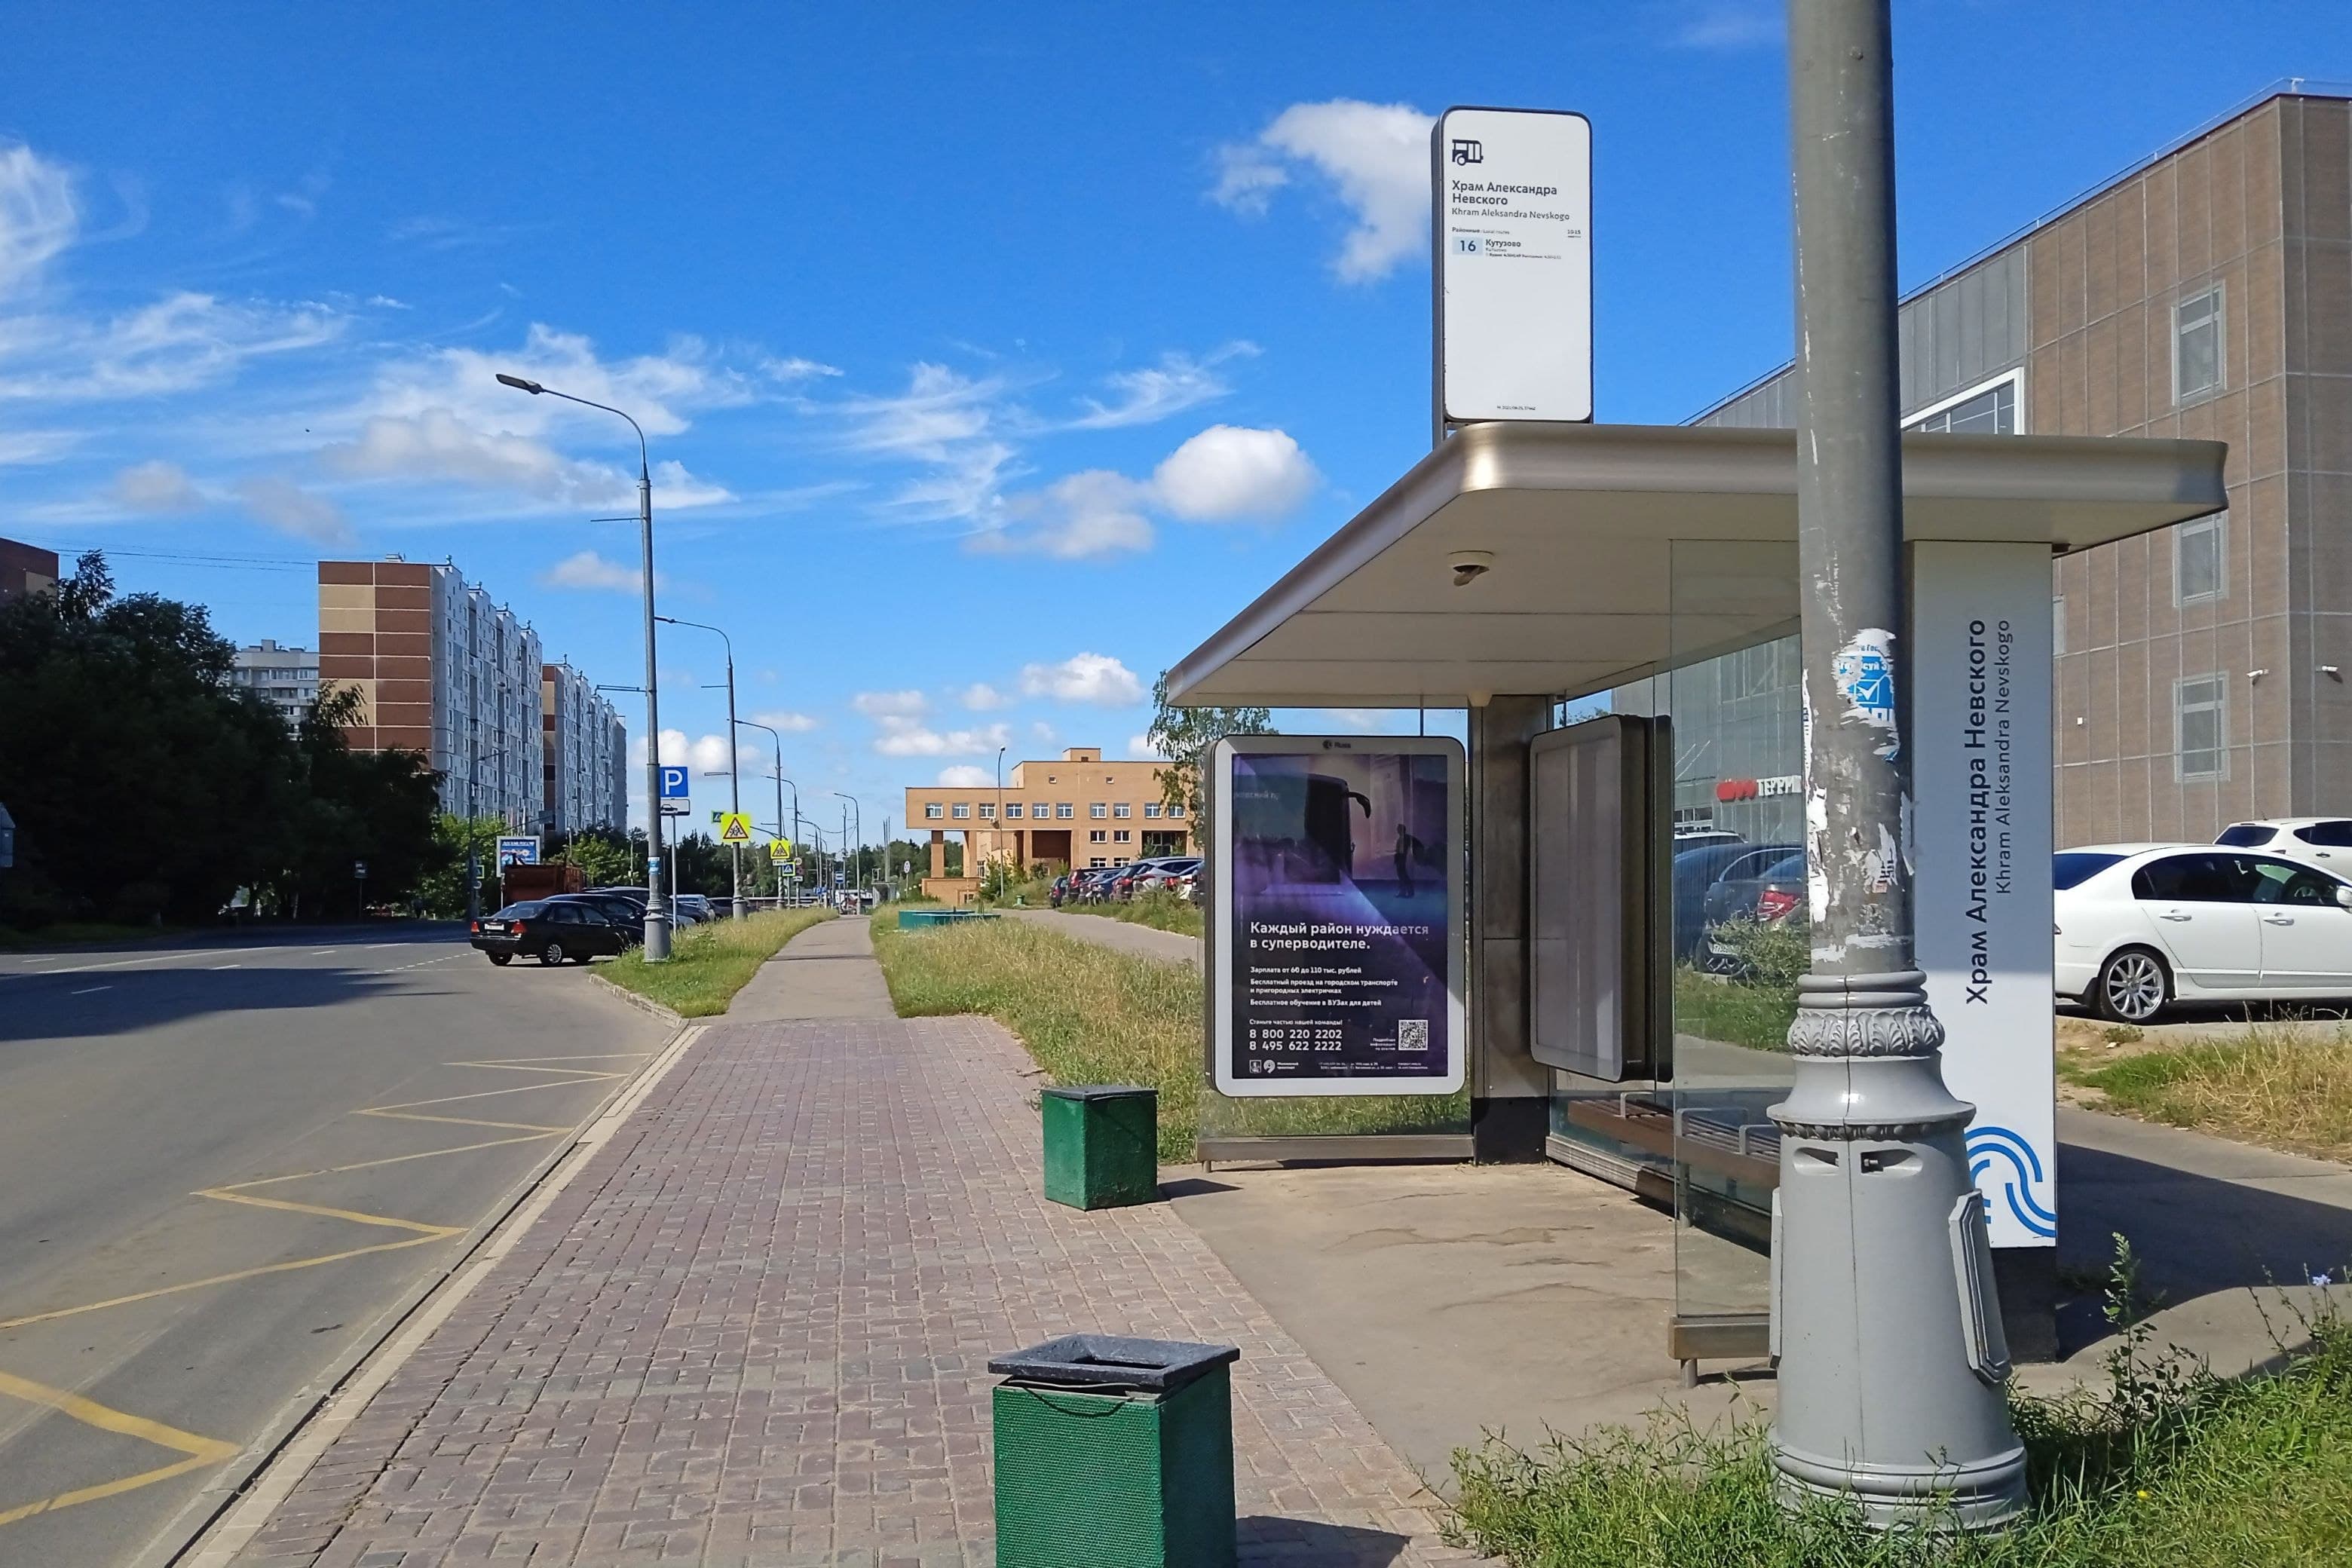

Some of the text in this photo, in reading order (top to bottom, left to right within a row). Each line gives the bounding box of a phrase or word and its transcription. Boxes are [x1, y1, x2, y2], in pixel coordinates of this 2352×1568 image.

[1452, 180, 1557, 196] Храм Александра
[1452, 193, 1508, 205] Невского
[1452, 207, 1570, 222] Khram Aleksandra Nevskogo
[1460, 240, 1476, 252] 16
[1486, 239, 1521, 247] Кутузово
[1994, 620, 2013, 895] Khram Aleksandra Nevskogo
[664, 770, 683, 795] P
[1965, 620, 1992, 1005] Храм Александра Невского
[1251, 922, 1429, 936] Каждый район нуждается
[1261, 939, 1370, 951] суперводителе.
[1290, 999, 1320, 1007] обучение
[1249, 1029, 1342, 1039] 8 800 220 2202
[1249, 1041, 1342, 1051] 8 495 622 2222
